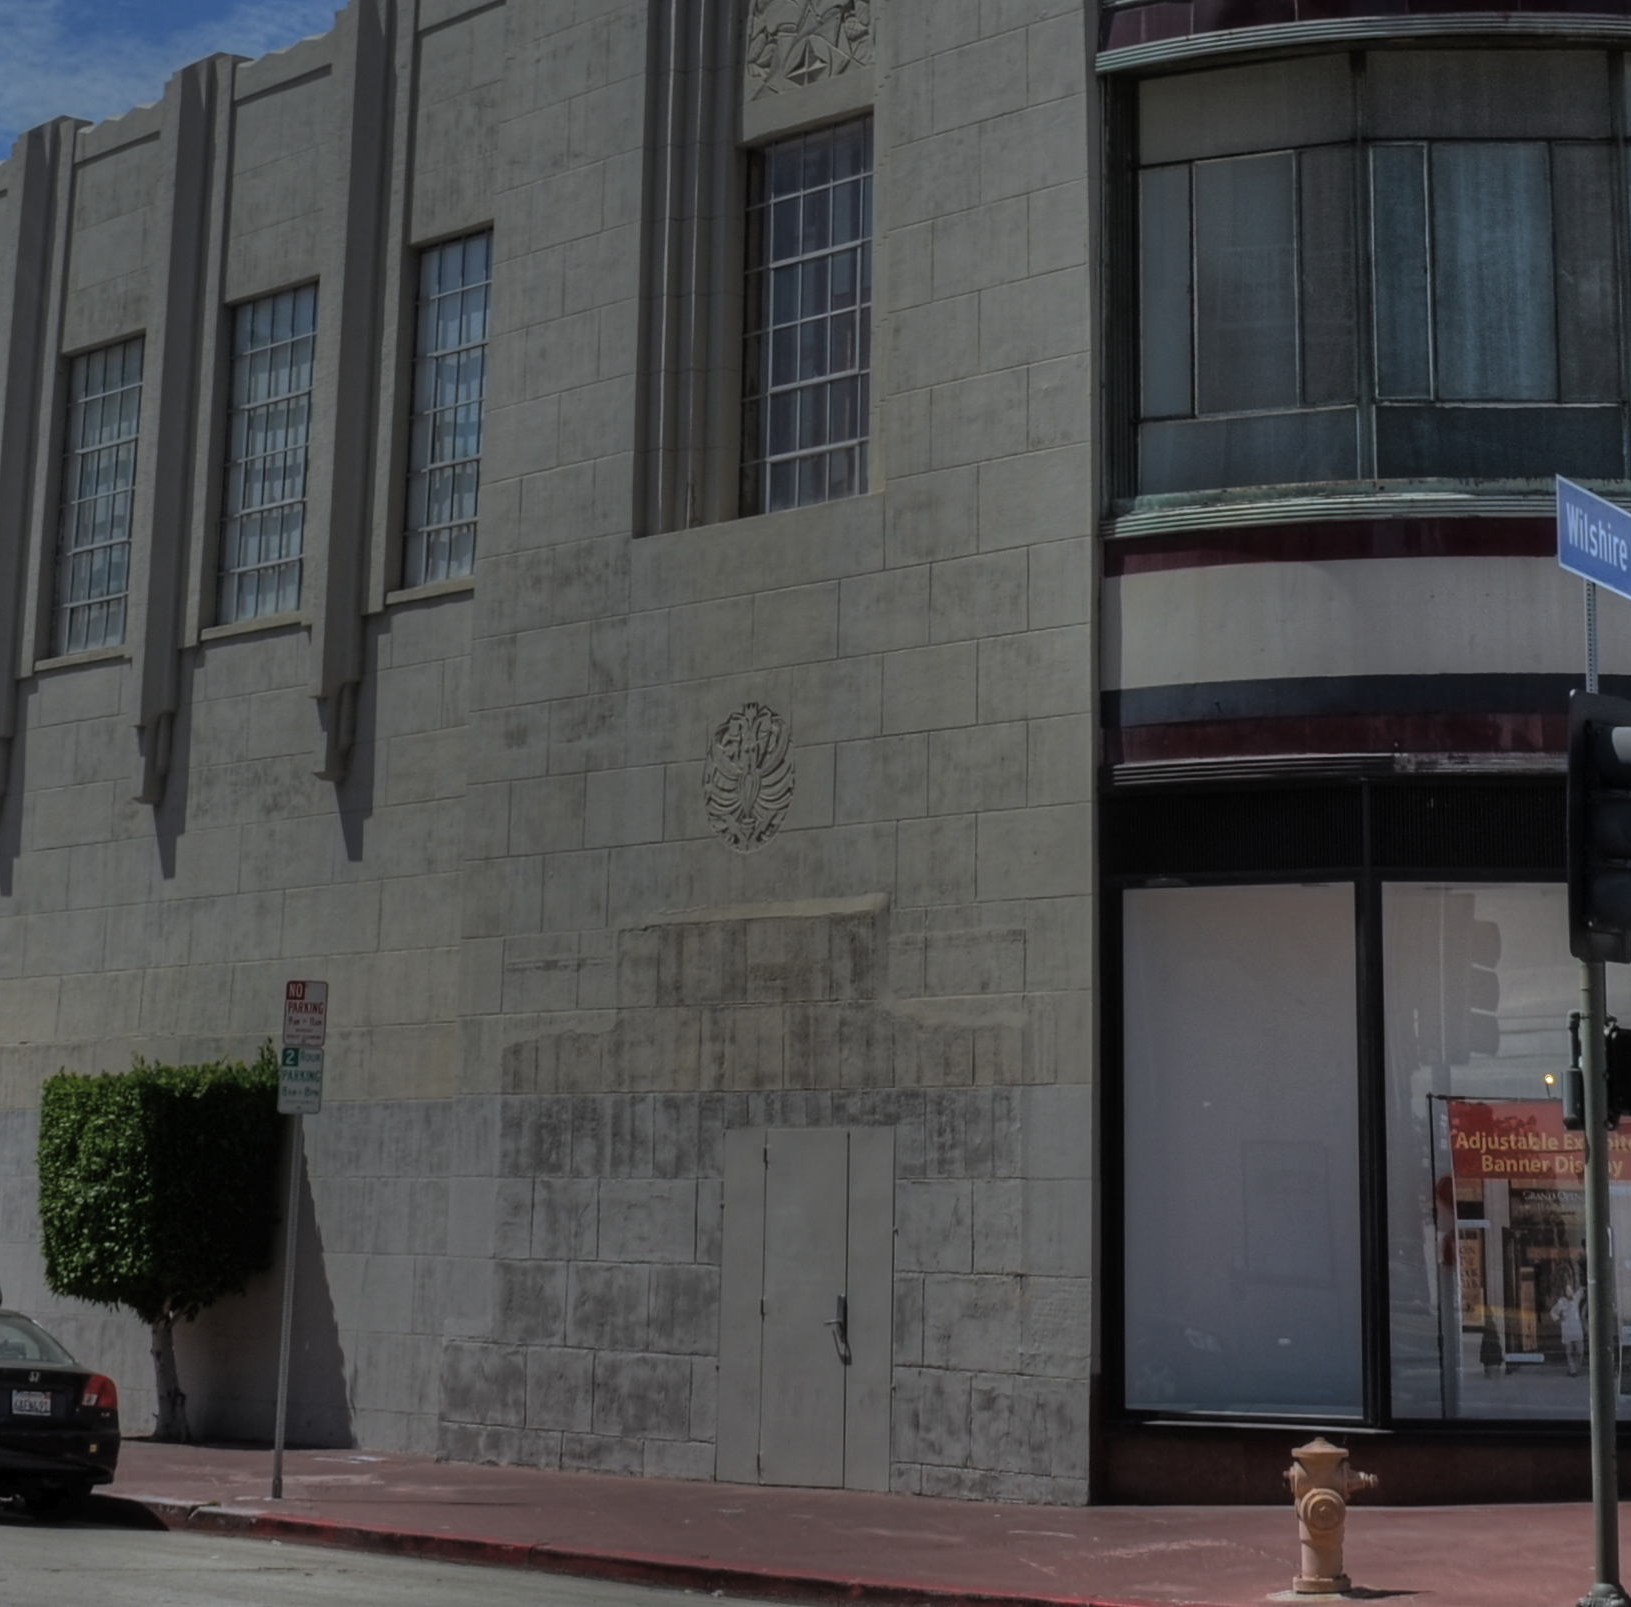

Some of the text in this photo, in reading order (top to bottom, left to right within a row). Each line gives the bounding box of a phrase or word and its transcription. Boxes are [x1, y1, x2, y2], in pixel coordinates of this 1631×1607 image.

[1565, 502, 1629, 572] Wilshire
[289, 983, 303, 997] NO
[287, 1002, 324, 1015] PARKING
[285, 1050, 295, 1064] 2
[282, 1069, 320, 1082] PARKING
[1455, 1132, 1558, 1153] Adjustable
[1482, 1155, 1623, 1177] Banner Disy
